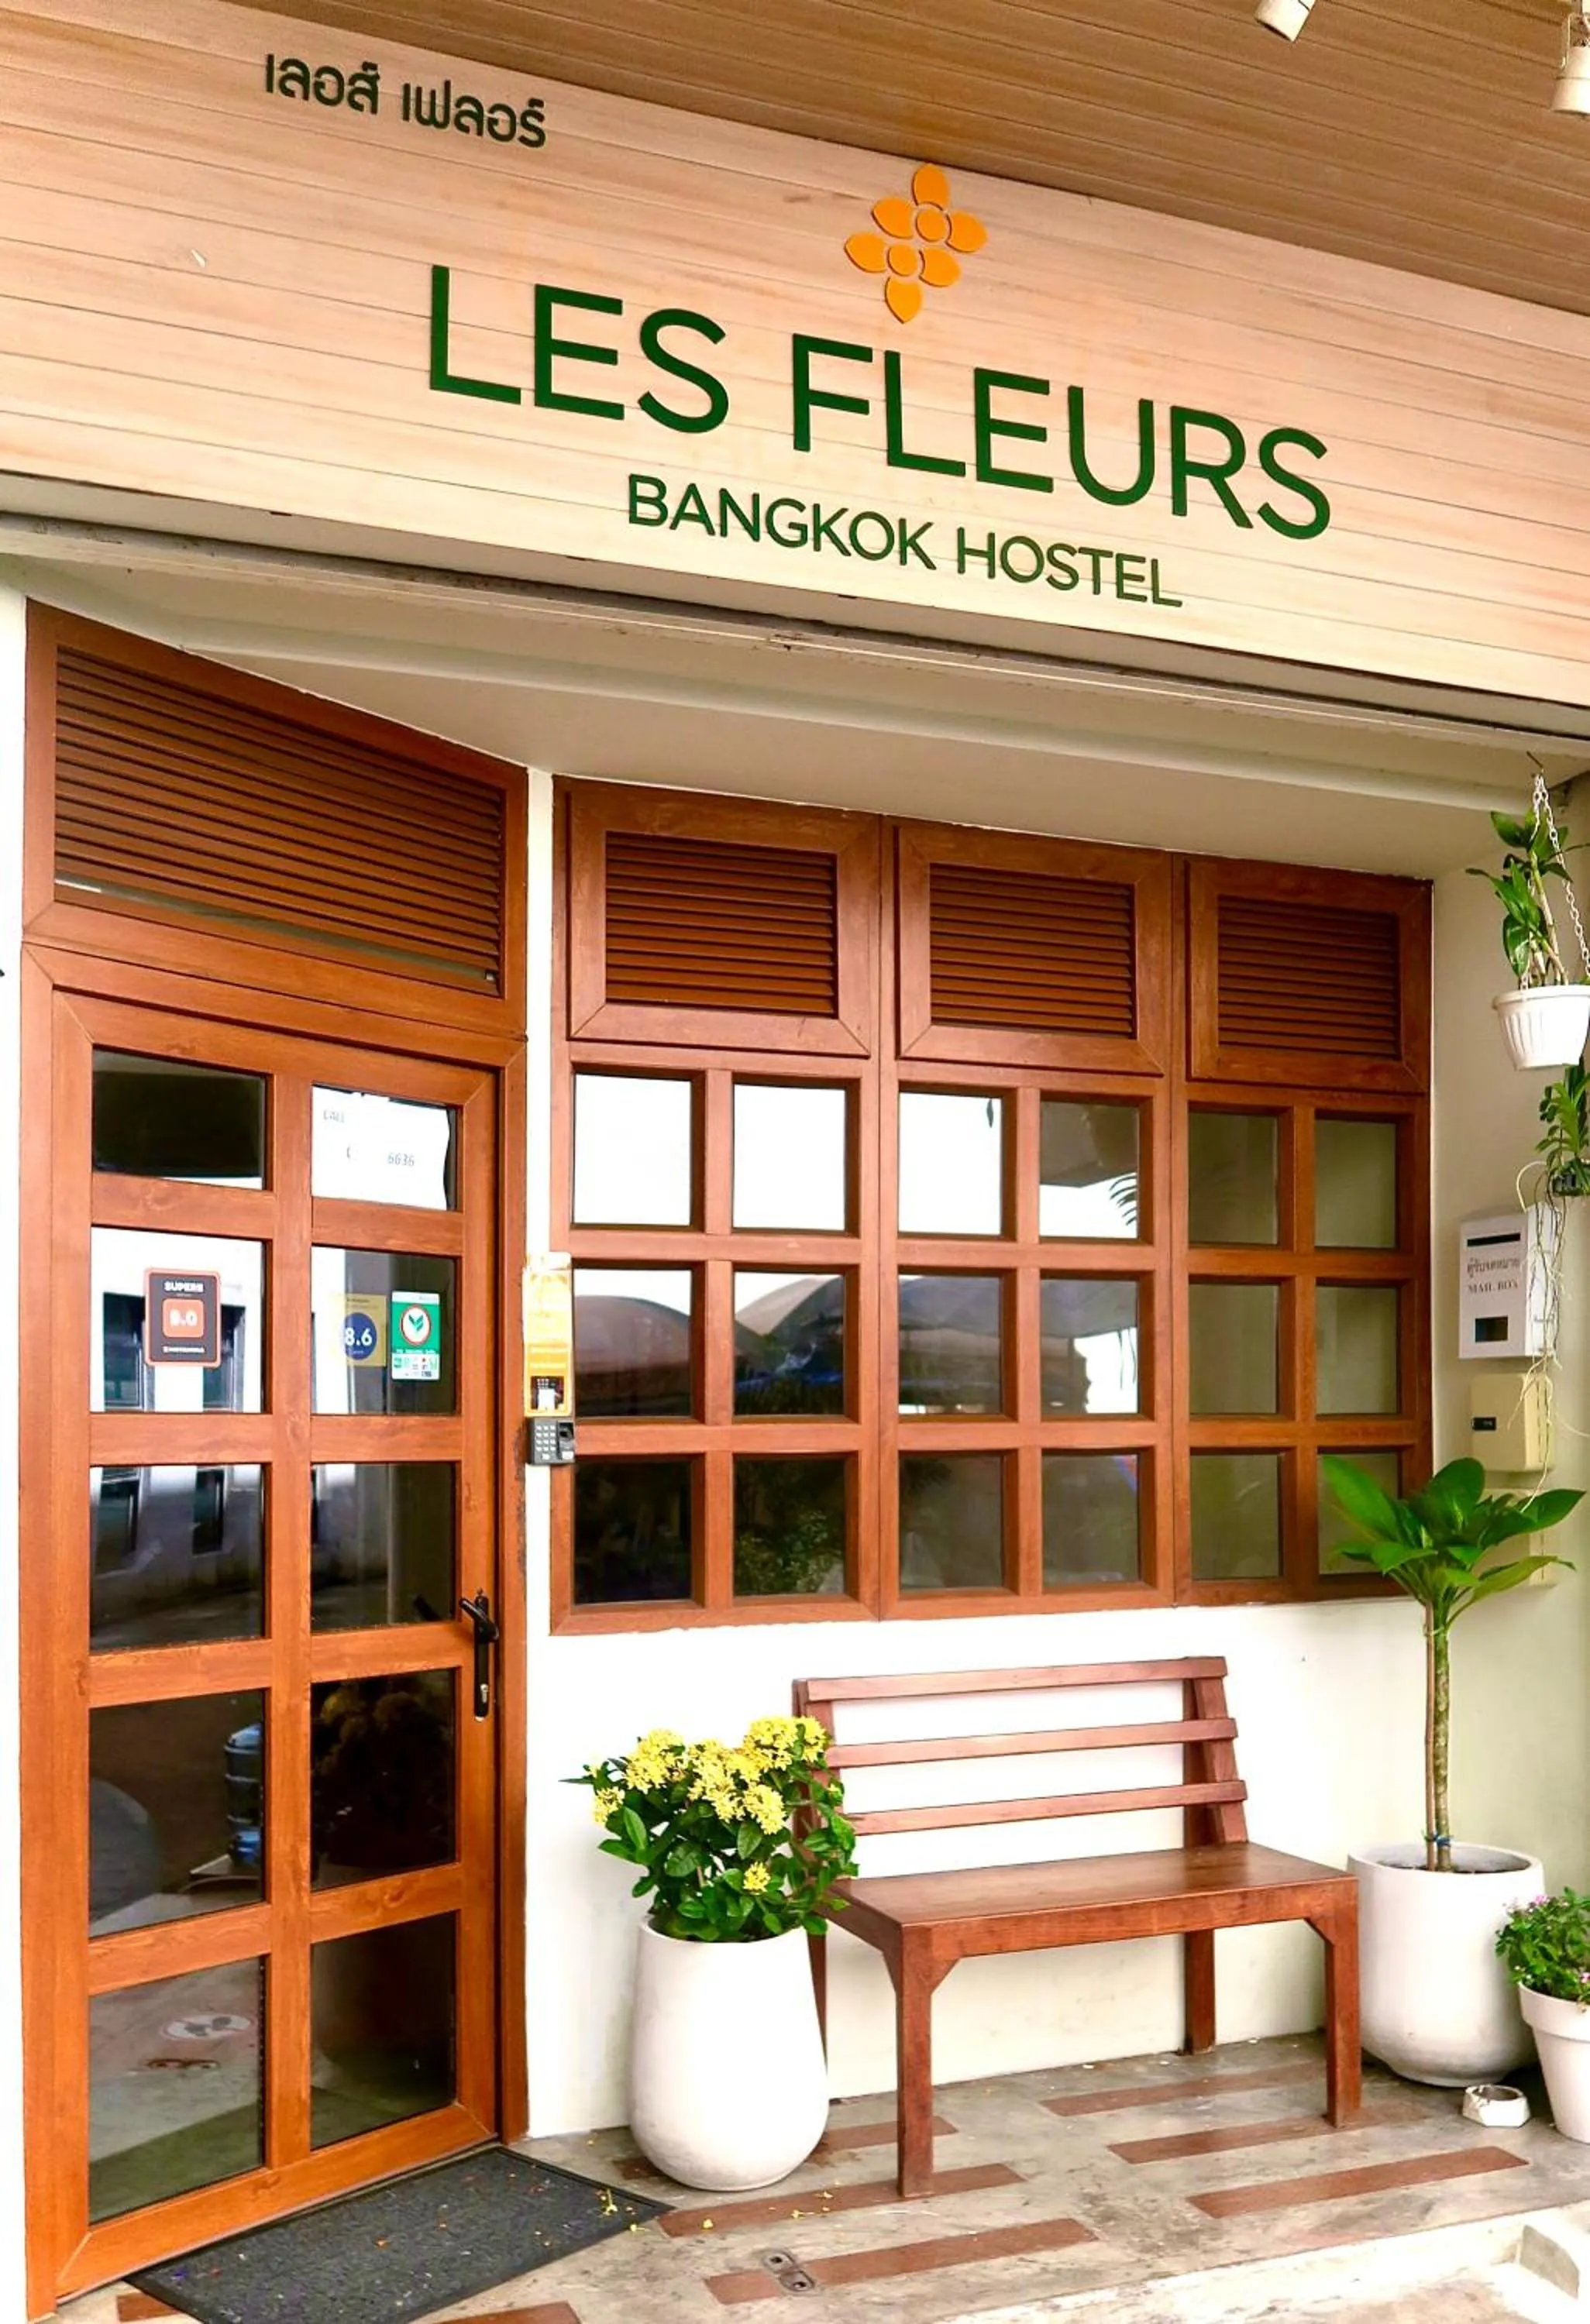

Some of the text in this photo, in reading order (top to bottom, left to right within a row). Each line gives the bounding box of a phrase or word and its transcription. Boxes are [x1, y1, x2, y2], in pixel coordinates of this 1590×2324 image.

[401, 79, 546, 148] เฟลอร์
[429, 265, 1331, 540] LES FLEURS
[628, 473, 1182, 607] BANGKOK HOSTEL
[344, 1326, 373, 1346] 8.6
